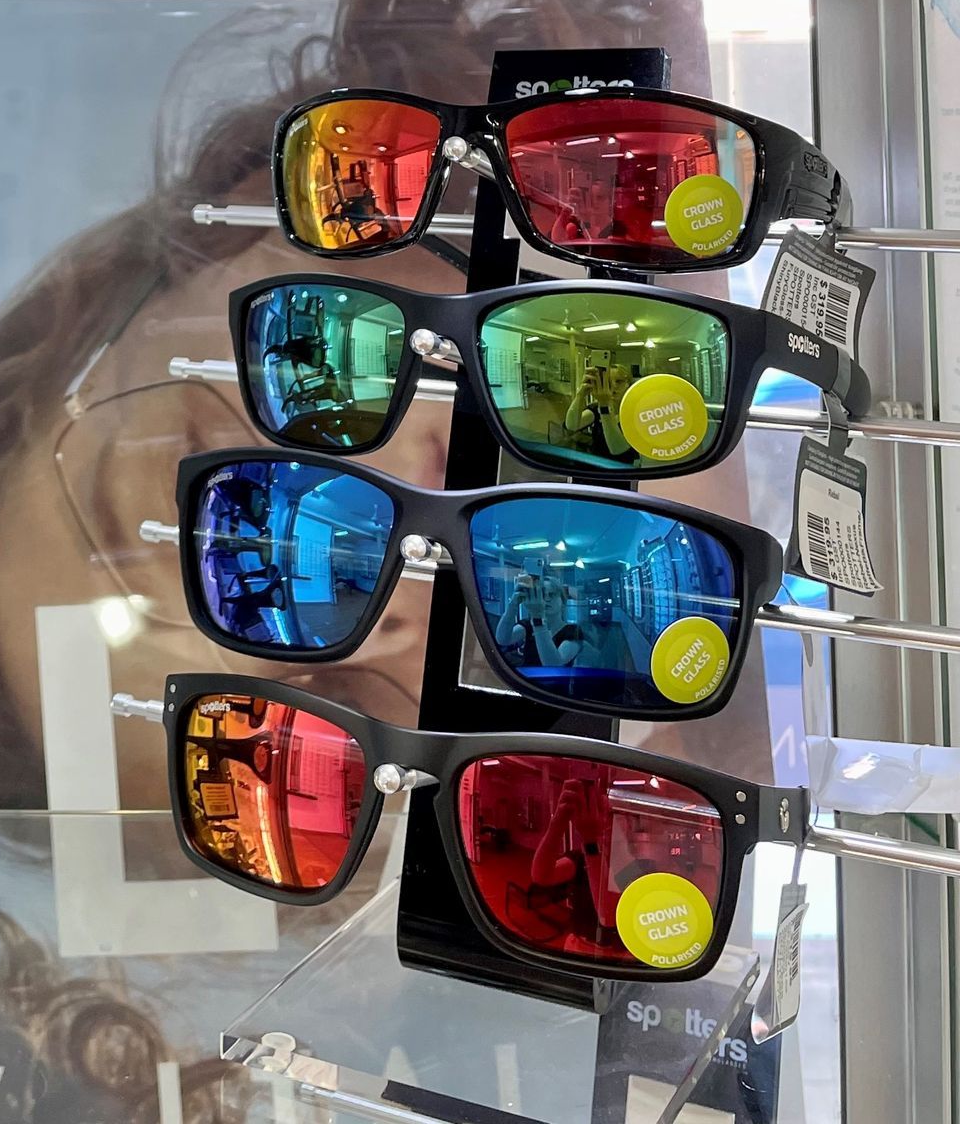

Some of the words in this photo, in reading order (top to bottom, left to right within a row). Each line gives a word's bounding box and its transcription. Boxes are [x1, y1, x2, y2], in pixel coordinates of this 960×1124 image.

[683, 198, 724, 218] CROWN
[691, 212, 724, 231] GLASS
[691, 229, 733, 251] POLARISED
[810, 294, 818, 316] GST
[787, 332, 820, 359] spotters
[638, 401, 684, 423] CROWN
[648, 416, 685, 436] GLASS
[652, 434, 697, 457] POLARISED
[823, 517, 836, 568] 319.95
[671, 638, 704, 678] CROWN
[683, 651, 711, 684] GLASS
[695, 659, 726, 699] POLARISED
[639, 904, 688, 926] CROWN
[648, 921, 689, 941] GLASS
[651, 942, 703, 964] POLARISED
